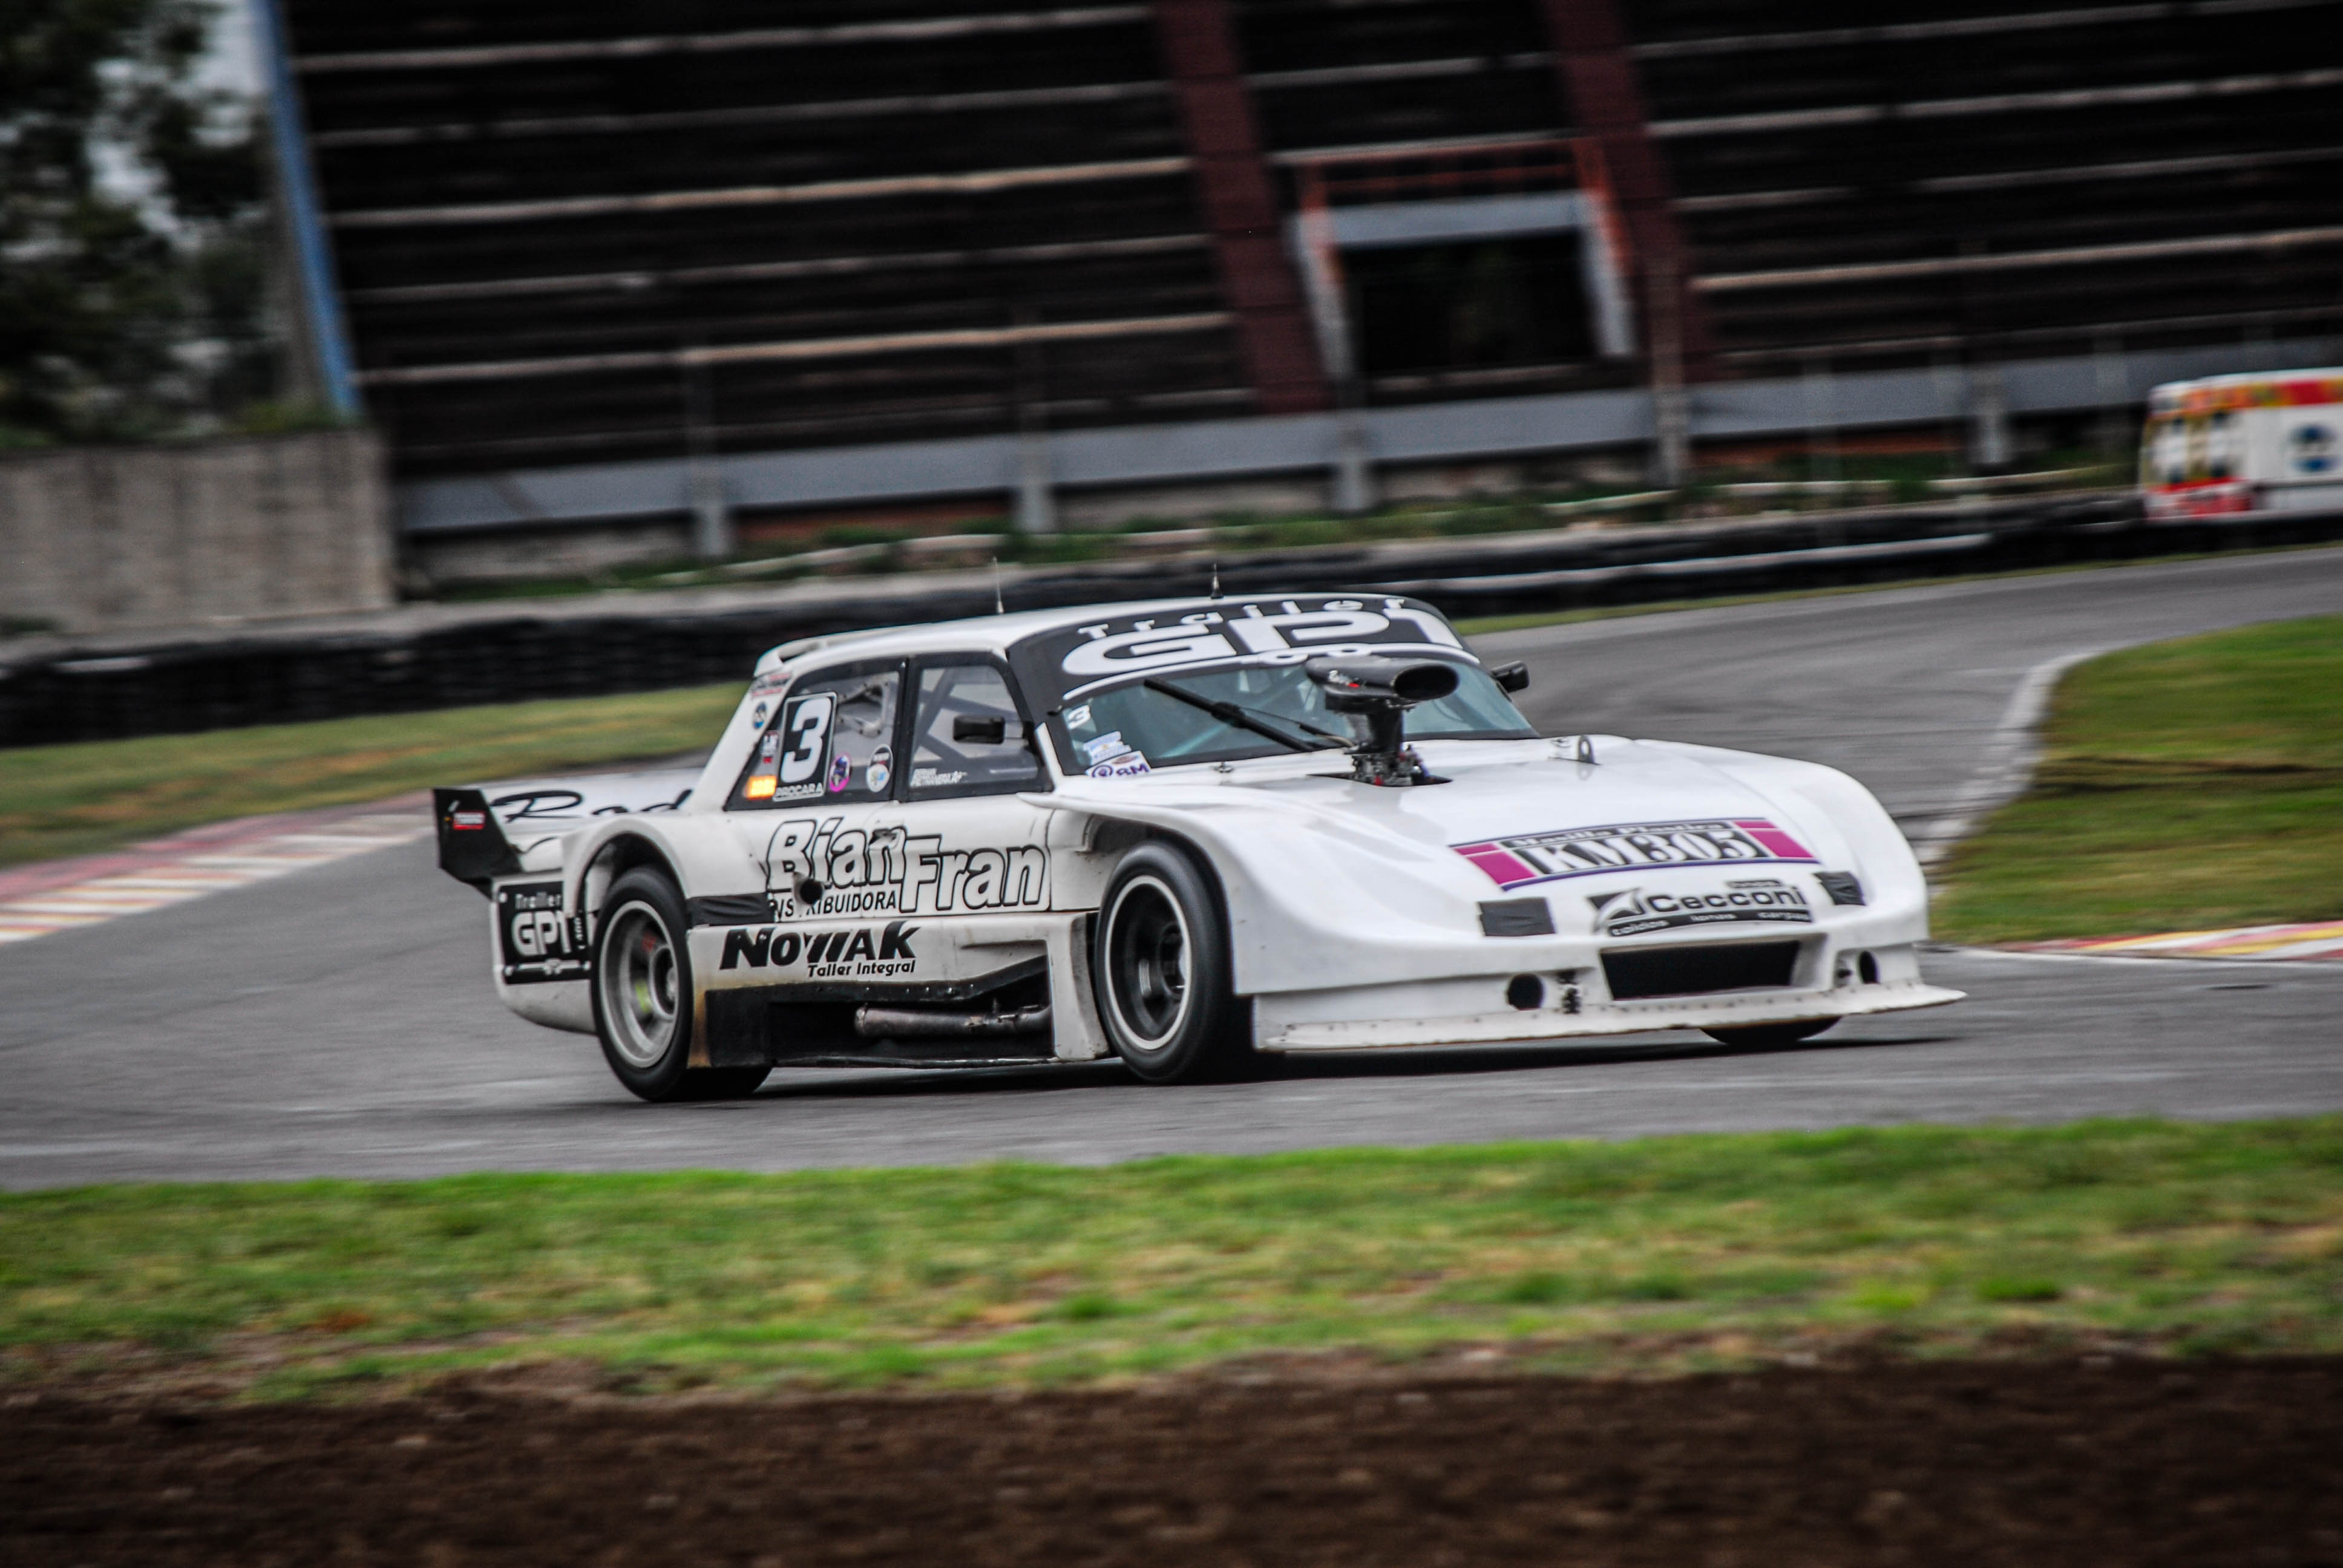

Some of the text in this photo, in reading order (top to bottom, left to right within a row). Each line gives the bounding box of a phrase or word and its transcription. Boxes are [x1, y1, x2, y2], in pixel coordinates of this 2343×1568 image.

[1062, 608, 1464, 675] GP1
[1067, 705, 1091, 730] 3
[781, 696, 831, 783] 3
[1525, 830, 1757, 874] KM305
[1647, 886, 1807, 912] Cecconi
[807, 960, 916, 978] Taller Integral
